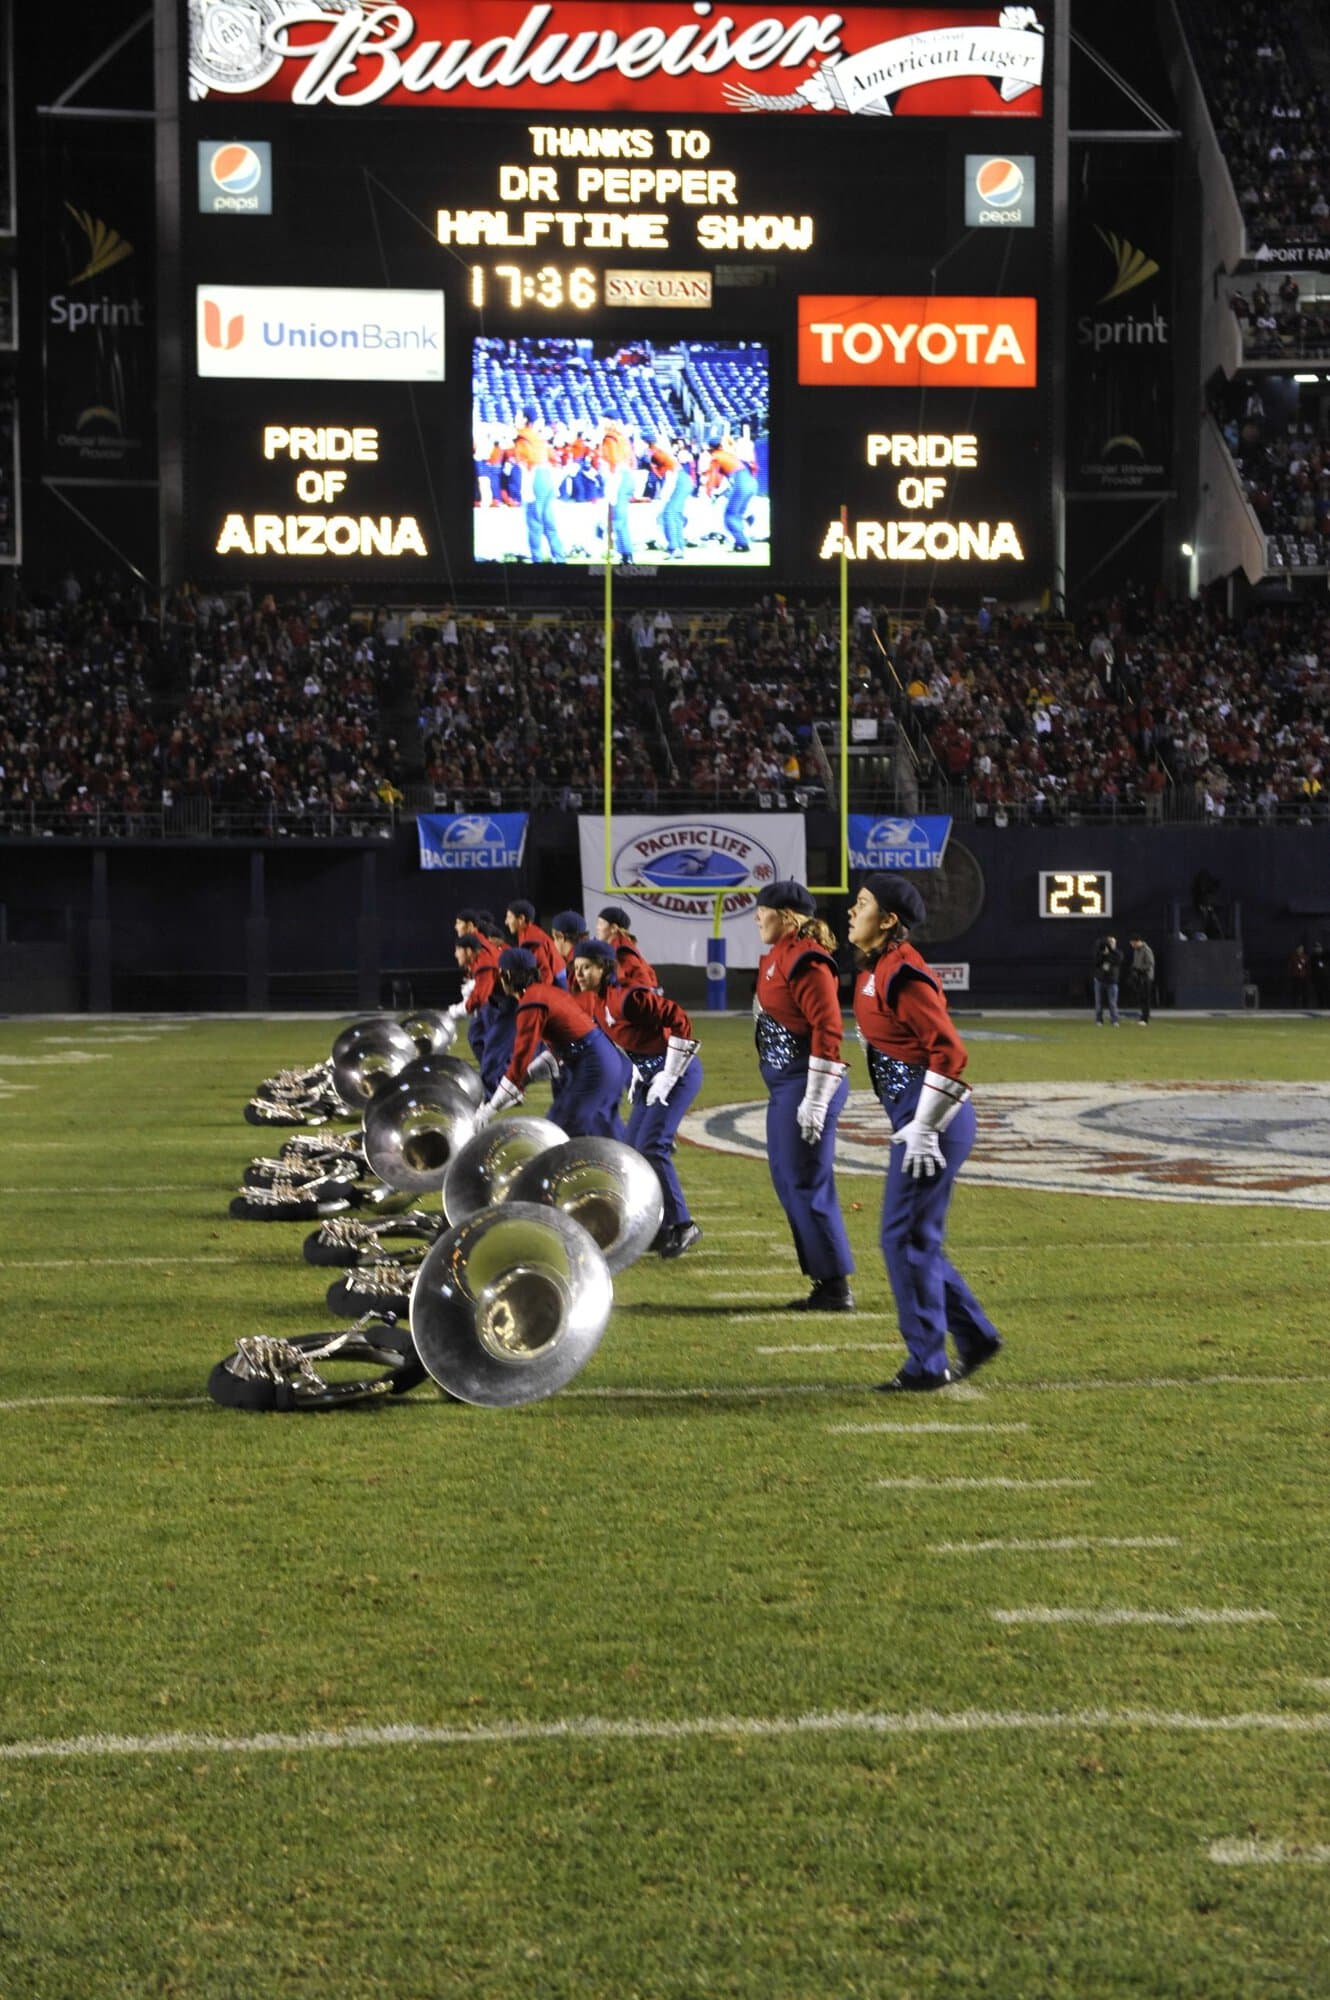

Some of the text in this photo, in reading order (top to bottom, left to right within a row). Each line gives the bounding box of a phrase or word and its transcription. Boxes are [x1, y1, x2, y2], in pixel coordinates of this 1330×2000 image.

[267, 3, 843, 106] Budweiser
[852, 42, 1035, 96] American Lager
[529, 126, 711, 159] THANKS TO
[499, 165, 739, 205] DR PEPPER
[213, 195, 259, 212] pepsi
[979, 208, 1022, 225] pepsi
[437, 209, 813, 251] HALFTIME SHOW
[608, 278, 709, 299] SYCUAN
[50, 295, 144, 332] Sprint
[262, 321, 438, 350] UnionBank
[810, 322, 1026, 364] TOYOTA
[1077, 315, 1168, 351] Sprint
[264, 426, 379, 461] PRIDE
[866, 434, 978, 468] PRIDE
[296, 470, 348, 503] OF
[897, 477, 947, 509] OF
[216, 514, 429, 556] ARIZONA
[819, 521, 1025, 560] ARIZONA
[420, 846, 519, 870] PACIFIC LIF
[634, 829, 753, 859] PACIFIC LIFE
[915, 847, 943, 868] LIF
[1050, 874, 1102, 915] 25
